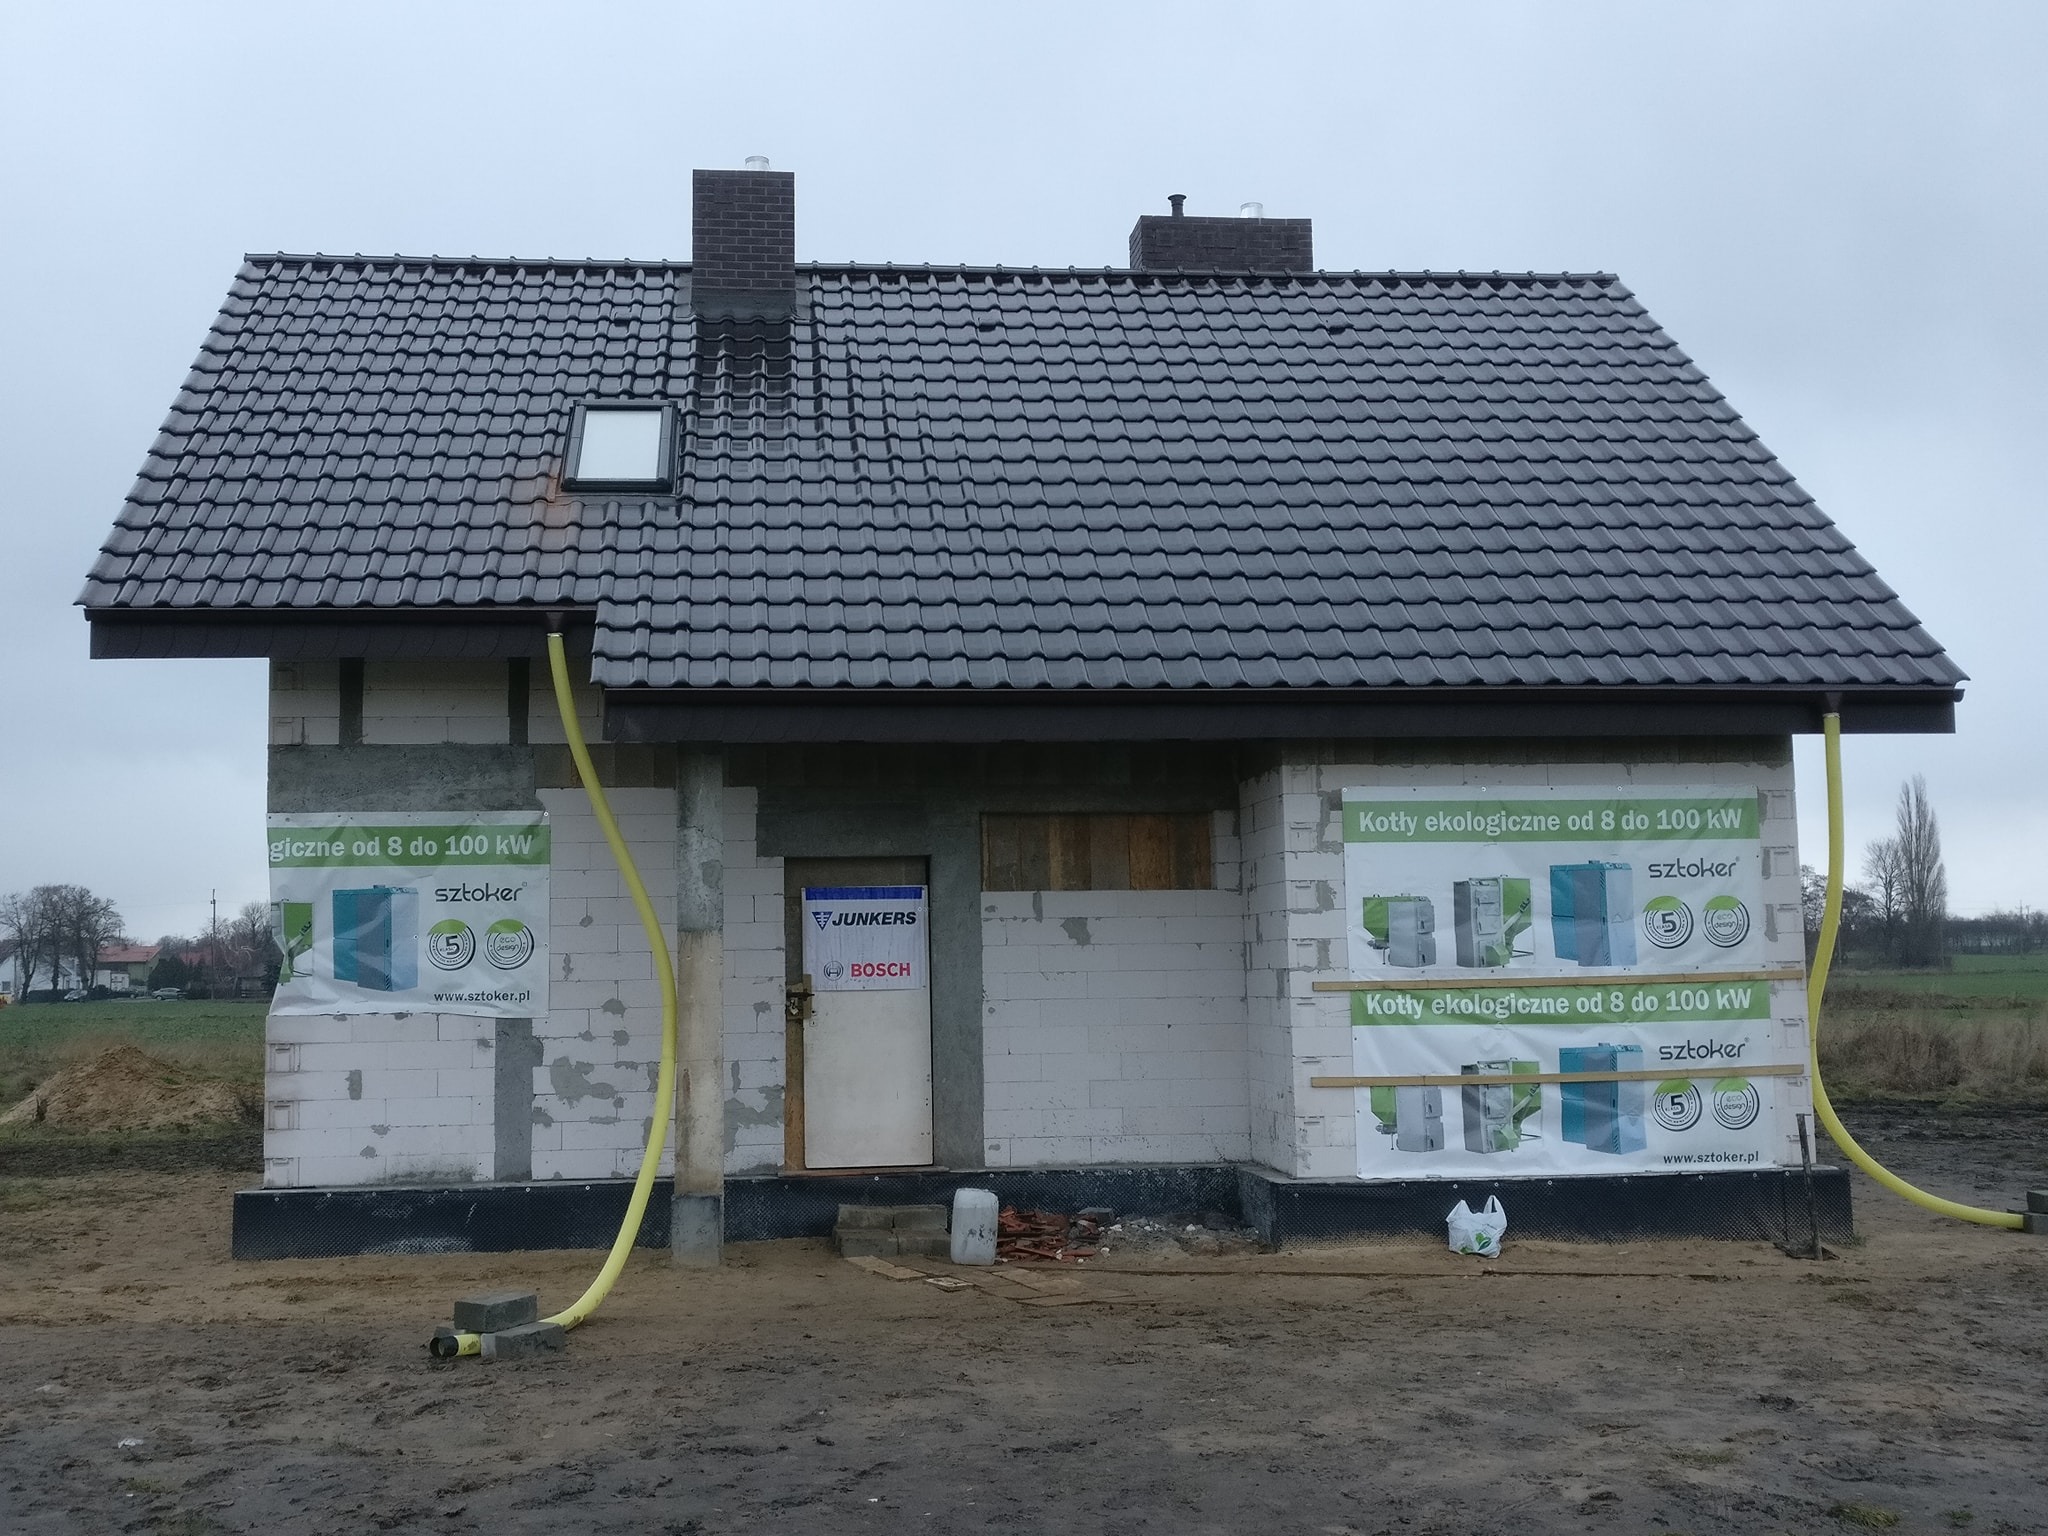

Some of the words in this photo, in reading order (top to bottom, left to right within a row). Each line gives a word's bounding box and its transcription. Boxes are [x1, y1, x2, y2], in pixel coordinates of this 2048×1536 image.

[1359, 811, 1418, 836] Kotły
[1425, 810, 1561, 836] ekologiczne
[1567, 810, 1594, 831] od
[1600, 810, 1615, 831] 8
[1621, 810, 1649, 831] do
[1656, 808, 1700, 830] 100
[1707, 808, 1742, 829] kW
[269, 837, 345, 862] giczne
[352, 836, 380, 857] od
[387, 836, 402, 856] 8
[409, 836, 437, 856] do
[445, 835, 488, 856] 100
[495, 834, 532, 855] kW
[1648, 857, 1737, 878] sztoker
[434, 883, 523, 902] sztoker
[832, 911, 917, 926] JUNKERS
[1661, 911, 1677, 933] 5
[446, 935, 460, 956] 5
[851, 962, 911, 978] BOSCH
[434, 990, 530, 1003] www.sztoker.pl
[1366, 993, 1425, 1020] Kotły
[1431, 992, 1570, 1019] ekologiczne
[1576, 992, 1603, 1013] od
[1610, 991, 1625, 1012] 8
[1631, 991, 1659, 1012] do
[1666, 989, 1710, 1011] 100
[1716, 988, 1751, 1010] kW
[1659, 1039, 1746, 1061] sztoker
[1670, 1094, 1686, 1116] 5
[1663, 1151, 1759, 1164] www.sztoker.pl
